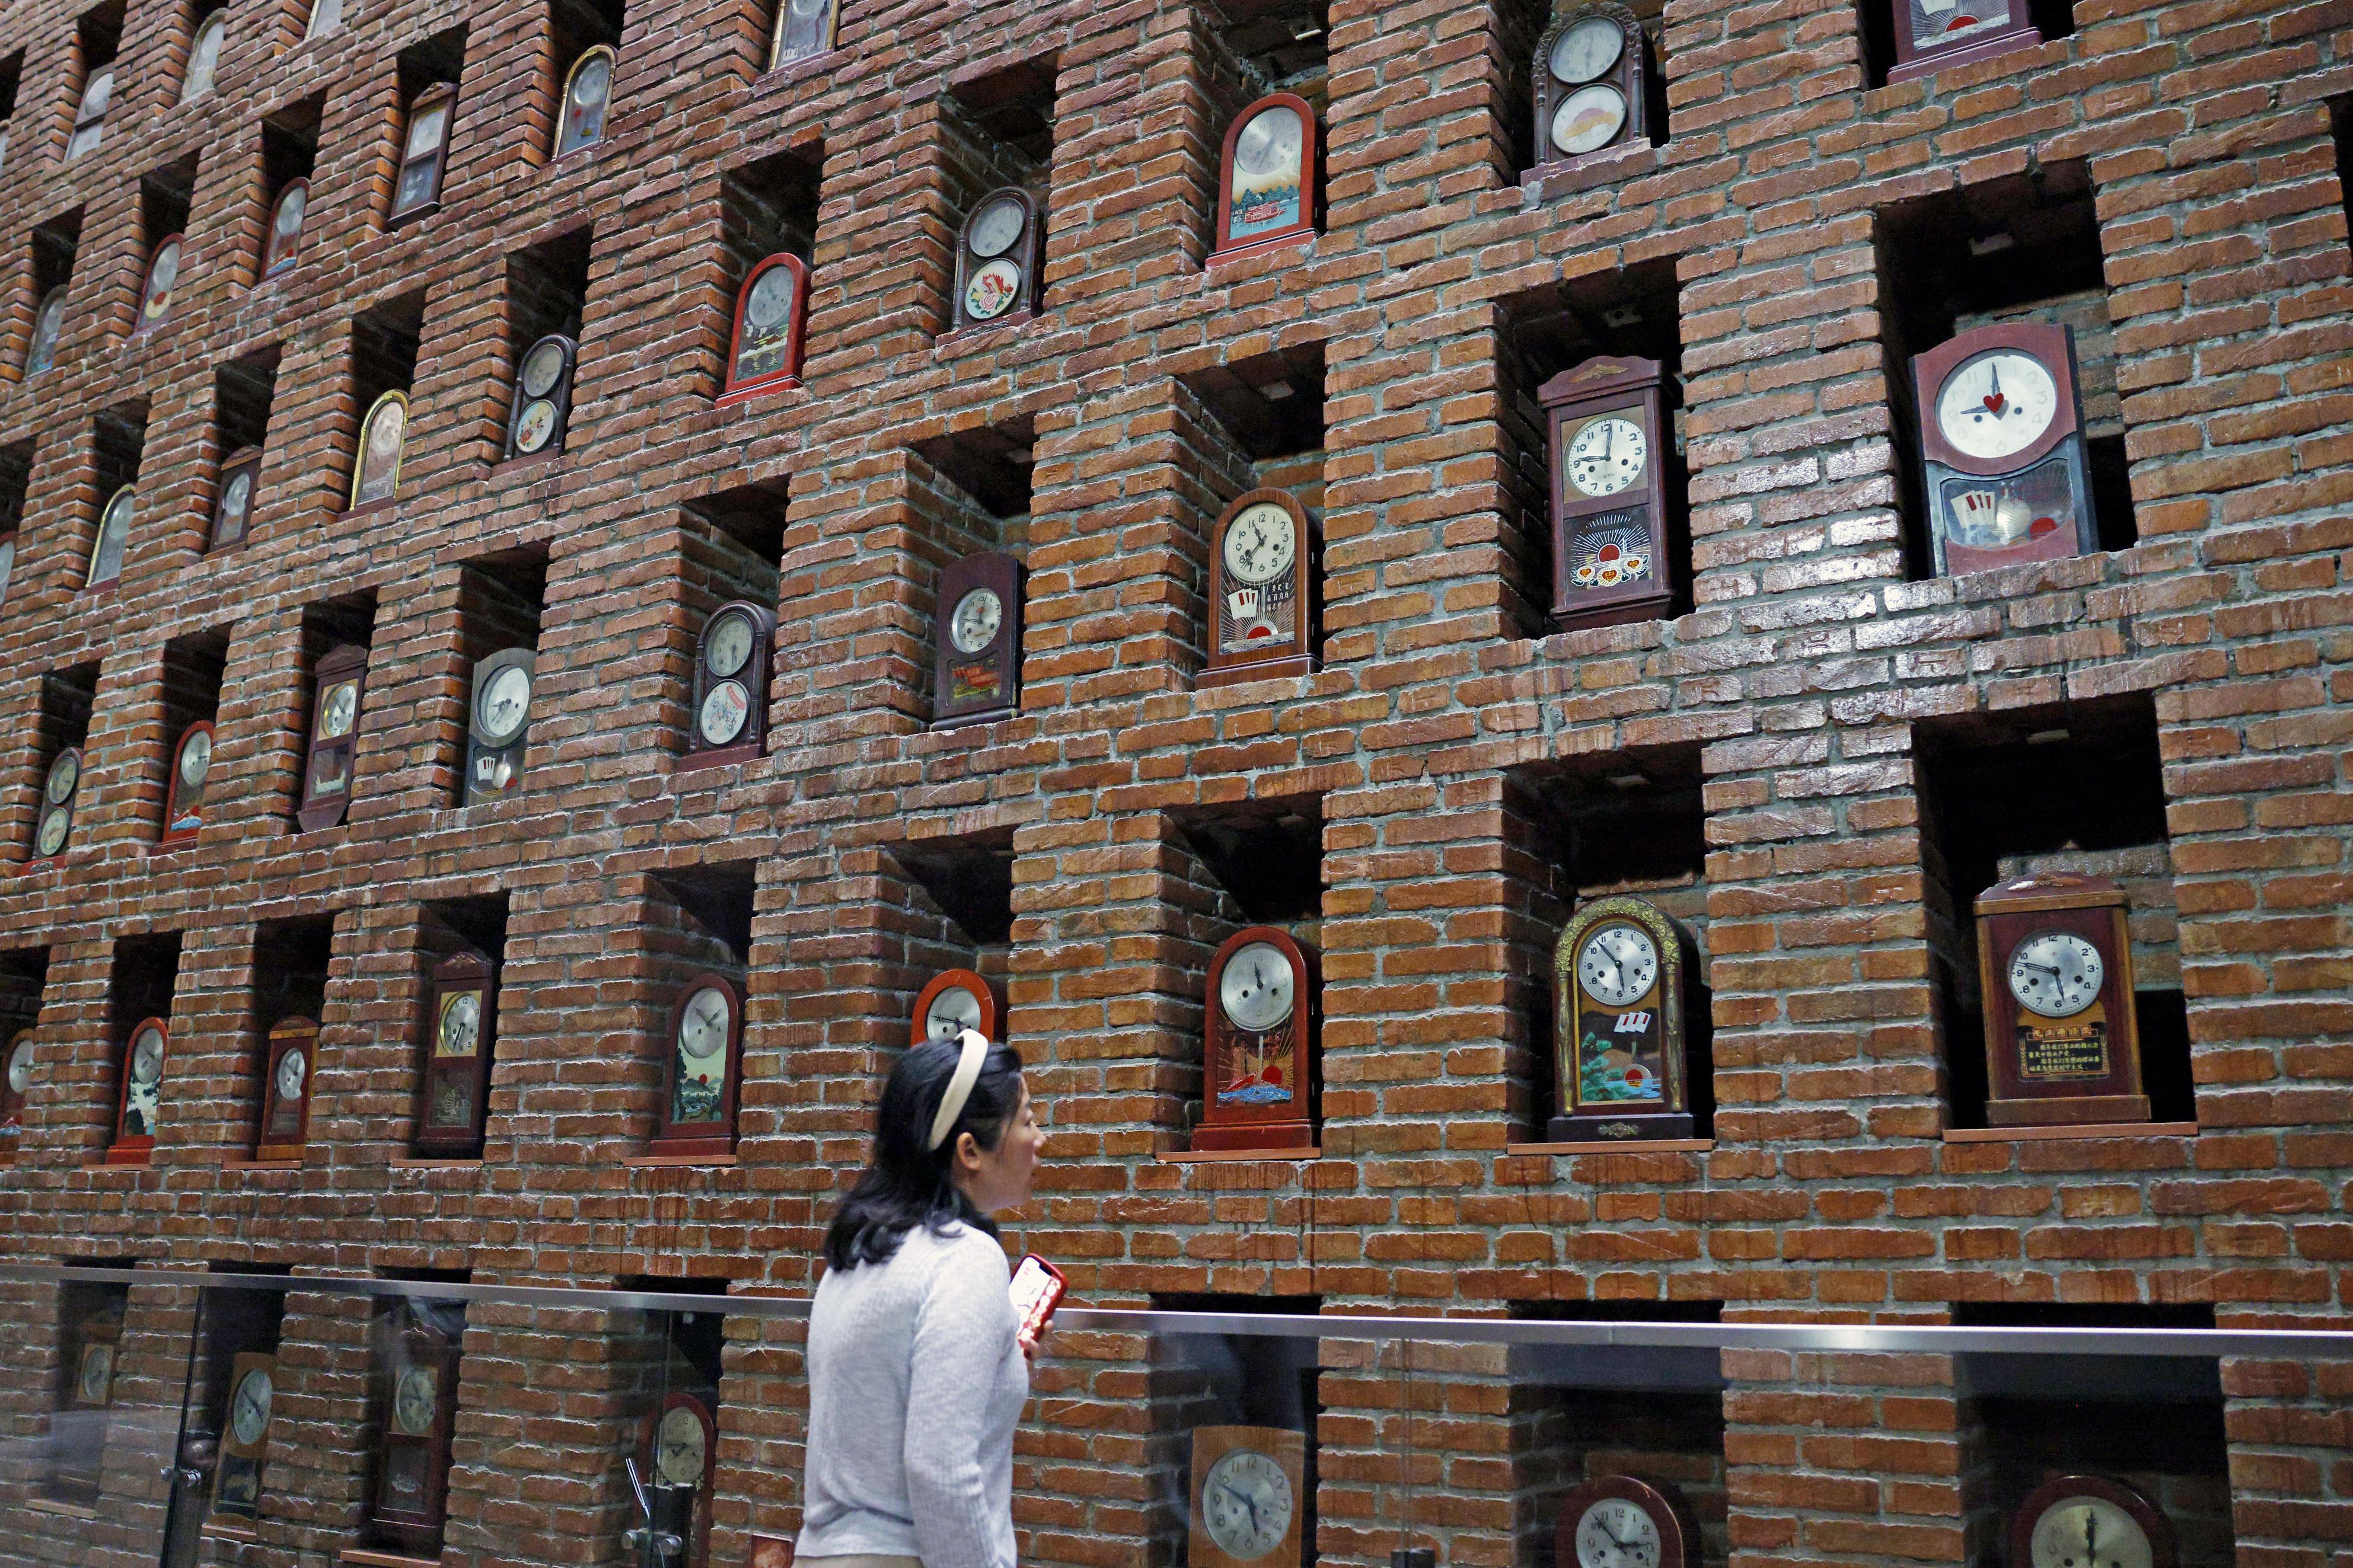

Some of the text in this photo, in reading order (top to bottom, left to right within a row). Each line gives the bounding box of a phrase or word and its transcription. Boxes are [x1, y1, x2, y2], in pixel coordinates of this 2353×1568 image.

[2026, 371, 2039, 384] 2
[2036, 391, 2048, 404] 3
[2032, 411, 2043, 425] 4
[1600, 423, 1611, 433] 12
[1619, 424, 1623, 432] 1
[1587, 431, 1594, 440] 11
[1629, 433, 1637, 442] 2
[1577, 443, 1587, 453] 10
[1634, 446, 1643, 455] 3
[1573, 459, 1581, 468] 9
[1631, 462, 1639, 471] 4
[1579, 474, 1586, 483] 8
[1621, 476, 1629, 485] 5
[1590, 482, 1598, 491] 7
[1605, 483, 1613, 492] 6
[1259, 514, 1266, 523] 12
[1273, 515, 1275, 523] 1
[1248, 519, 1254, 529] 11
[1280, 521, 1286, 530] 2
[1239, 531, 1246, 539] 10
[1283, 534, 1289, 542] 3
[1236, 543, 1242, 551] 9
[1278, 547, 1286, 556] 4
[1239, 555, 1245, 564] 8
[1271, 558, 1277, 567] 5
[1259, 563, 1265, 572] 6
[2087, 965, 2095, 973] 3
[2023, 985, 2030, 993] 8
[1236, 995, 1242, 1005] 8
[2072, 995, 2080, 1003] 5
[1232, 1461, 1240, 1473] 11
[1247, 1456, 1257, 1469] 12
[1276, 1475, 1284, 1489] 2
[1280, 1499, 1289, 1511] 3
[1615, 1508, 1625, 1518] 12
[1633, 1513, 1637, 1522] 1
[1217, 1514, 1225, 1527] 8
[1642, 1523, 1649, 1535] 2
